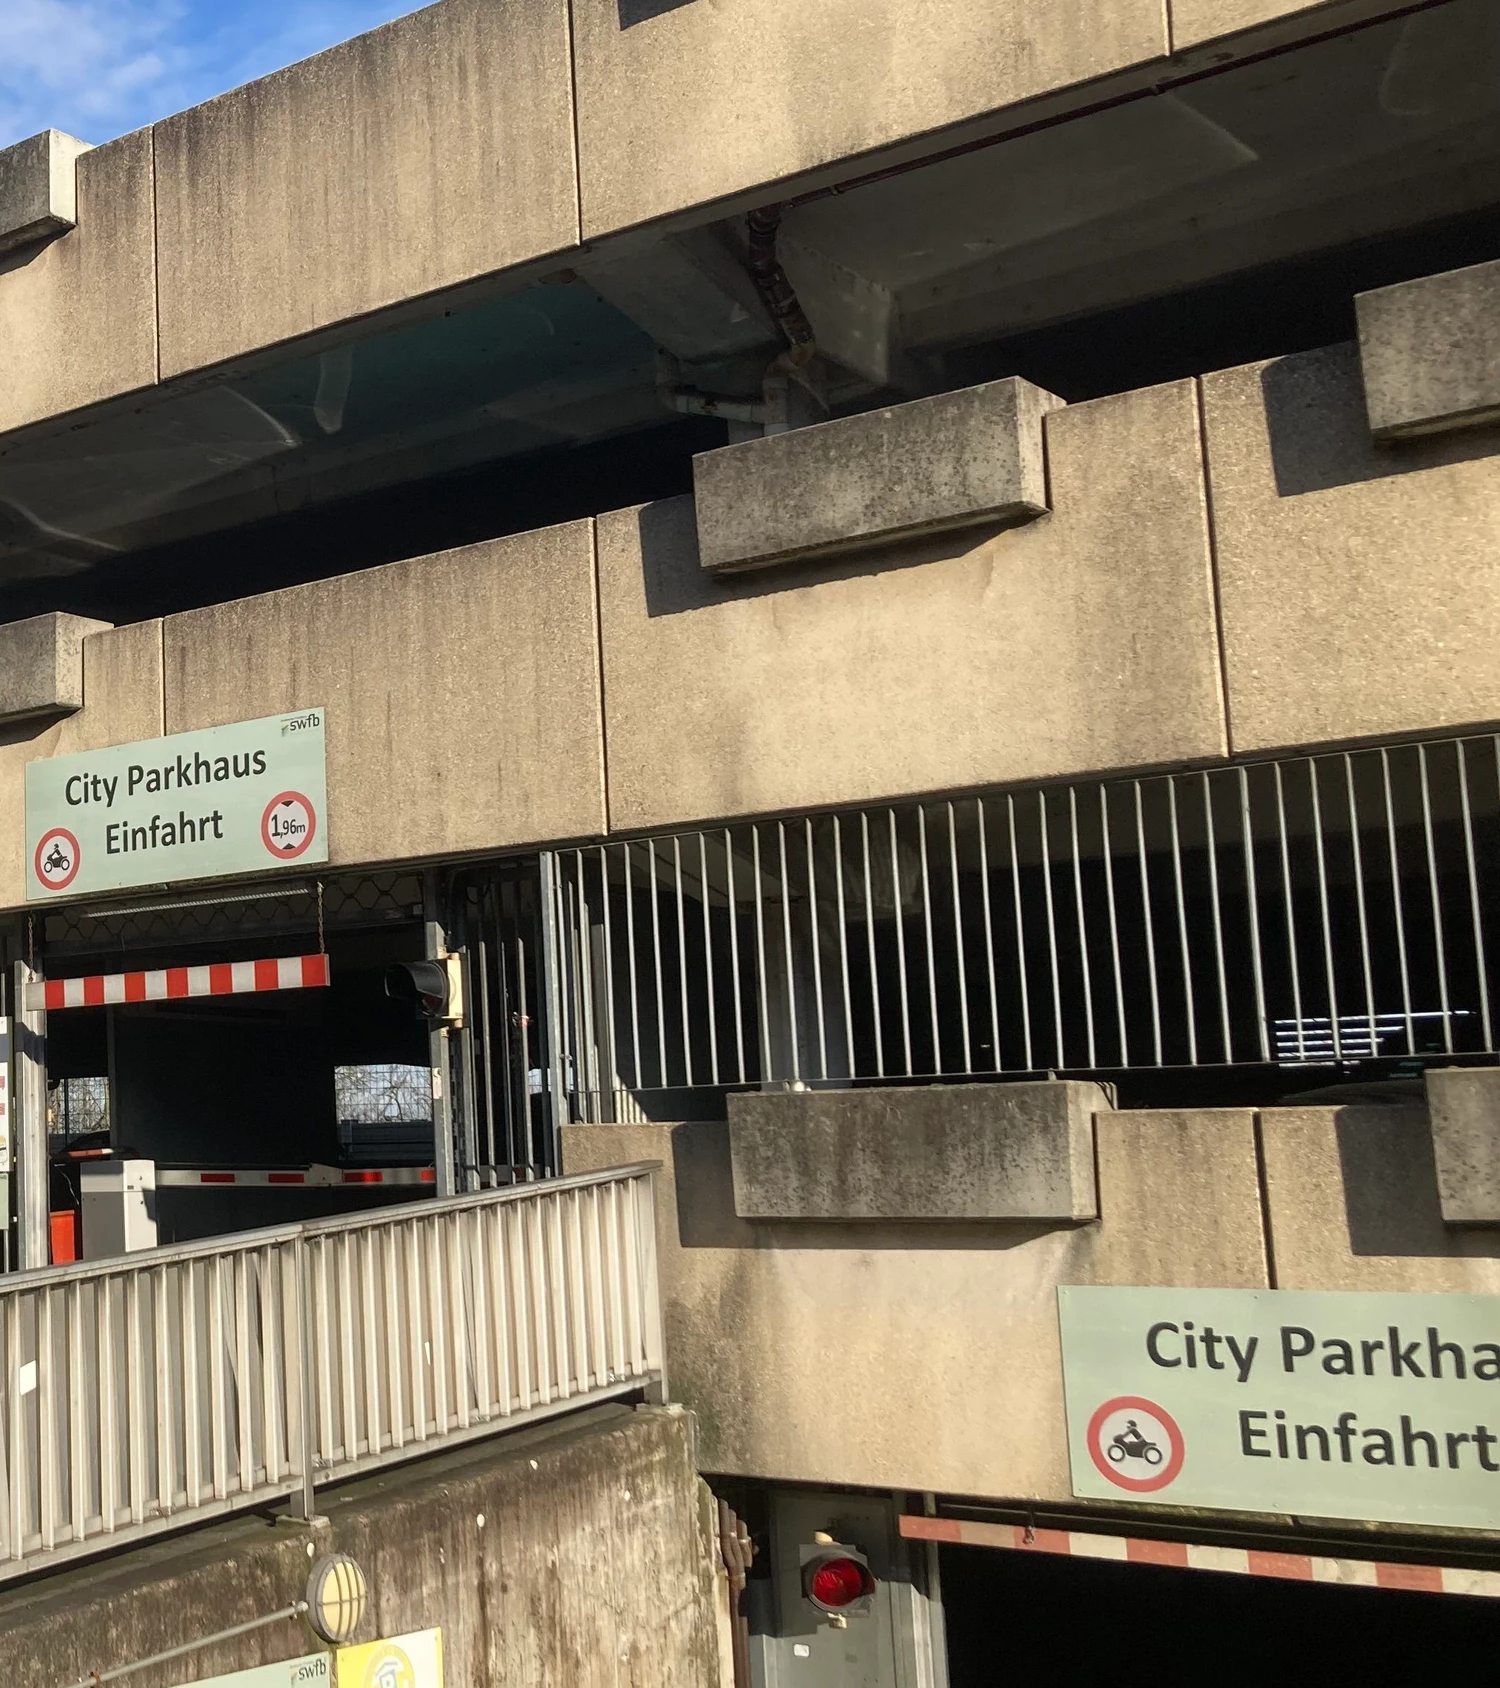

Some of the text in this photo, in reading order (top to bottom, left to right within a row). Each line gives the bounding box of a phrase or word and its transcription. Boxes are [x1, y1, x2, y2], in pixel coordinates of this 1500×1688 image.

[289, 713, 320, 731] swfb
[65, 749, 267, 807] City Parkhaus
[106, 809, 224, 854] Einfahrt
[1145, 1320, 1500, 1383] City Parkha
[1238, 1409, 1500, 1473] Einfahrt
[298, 1658, 327, 1681] swfb
